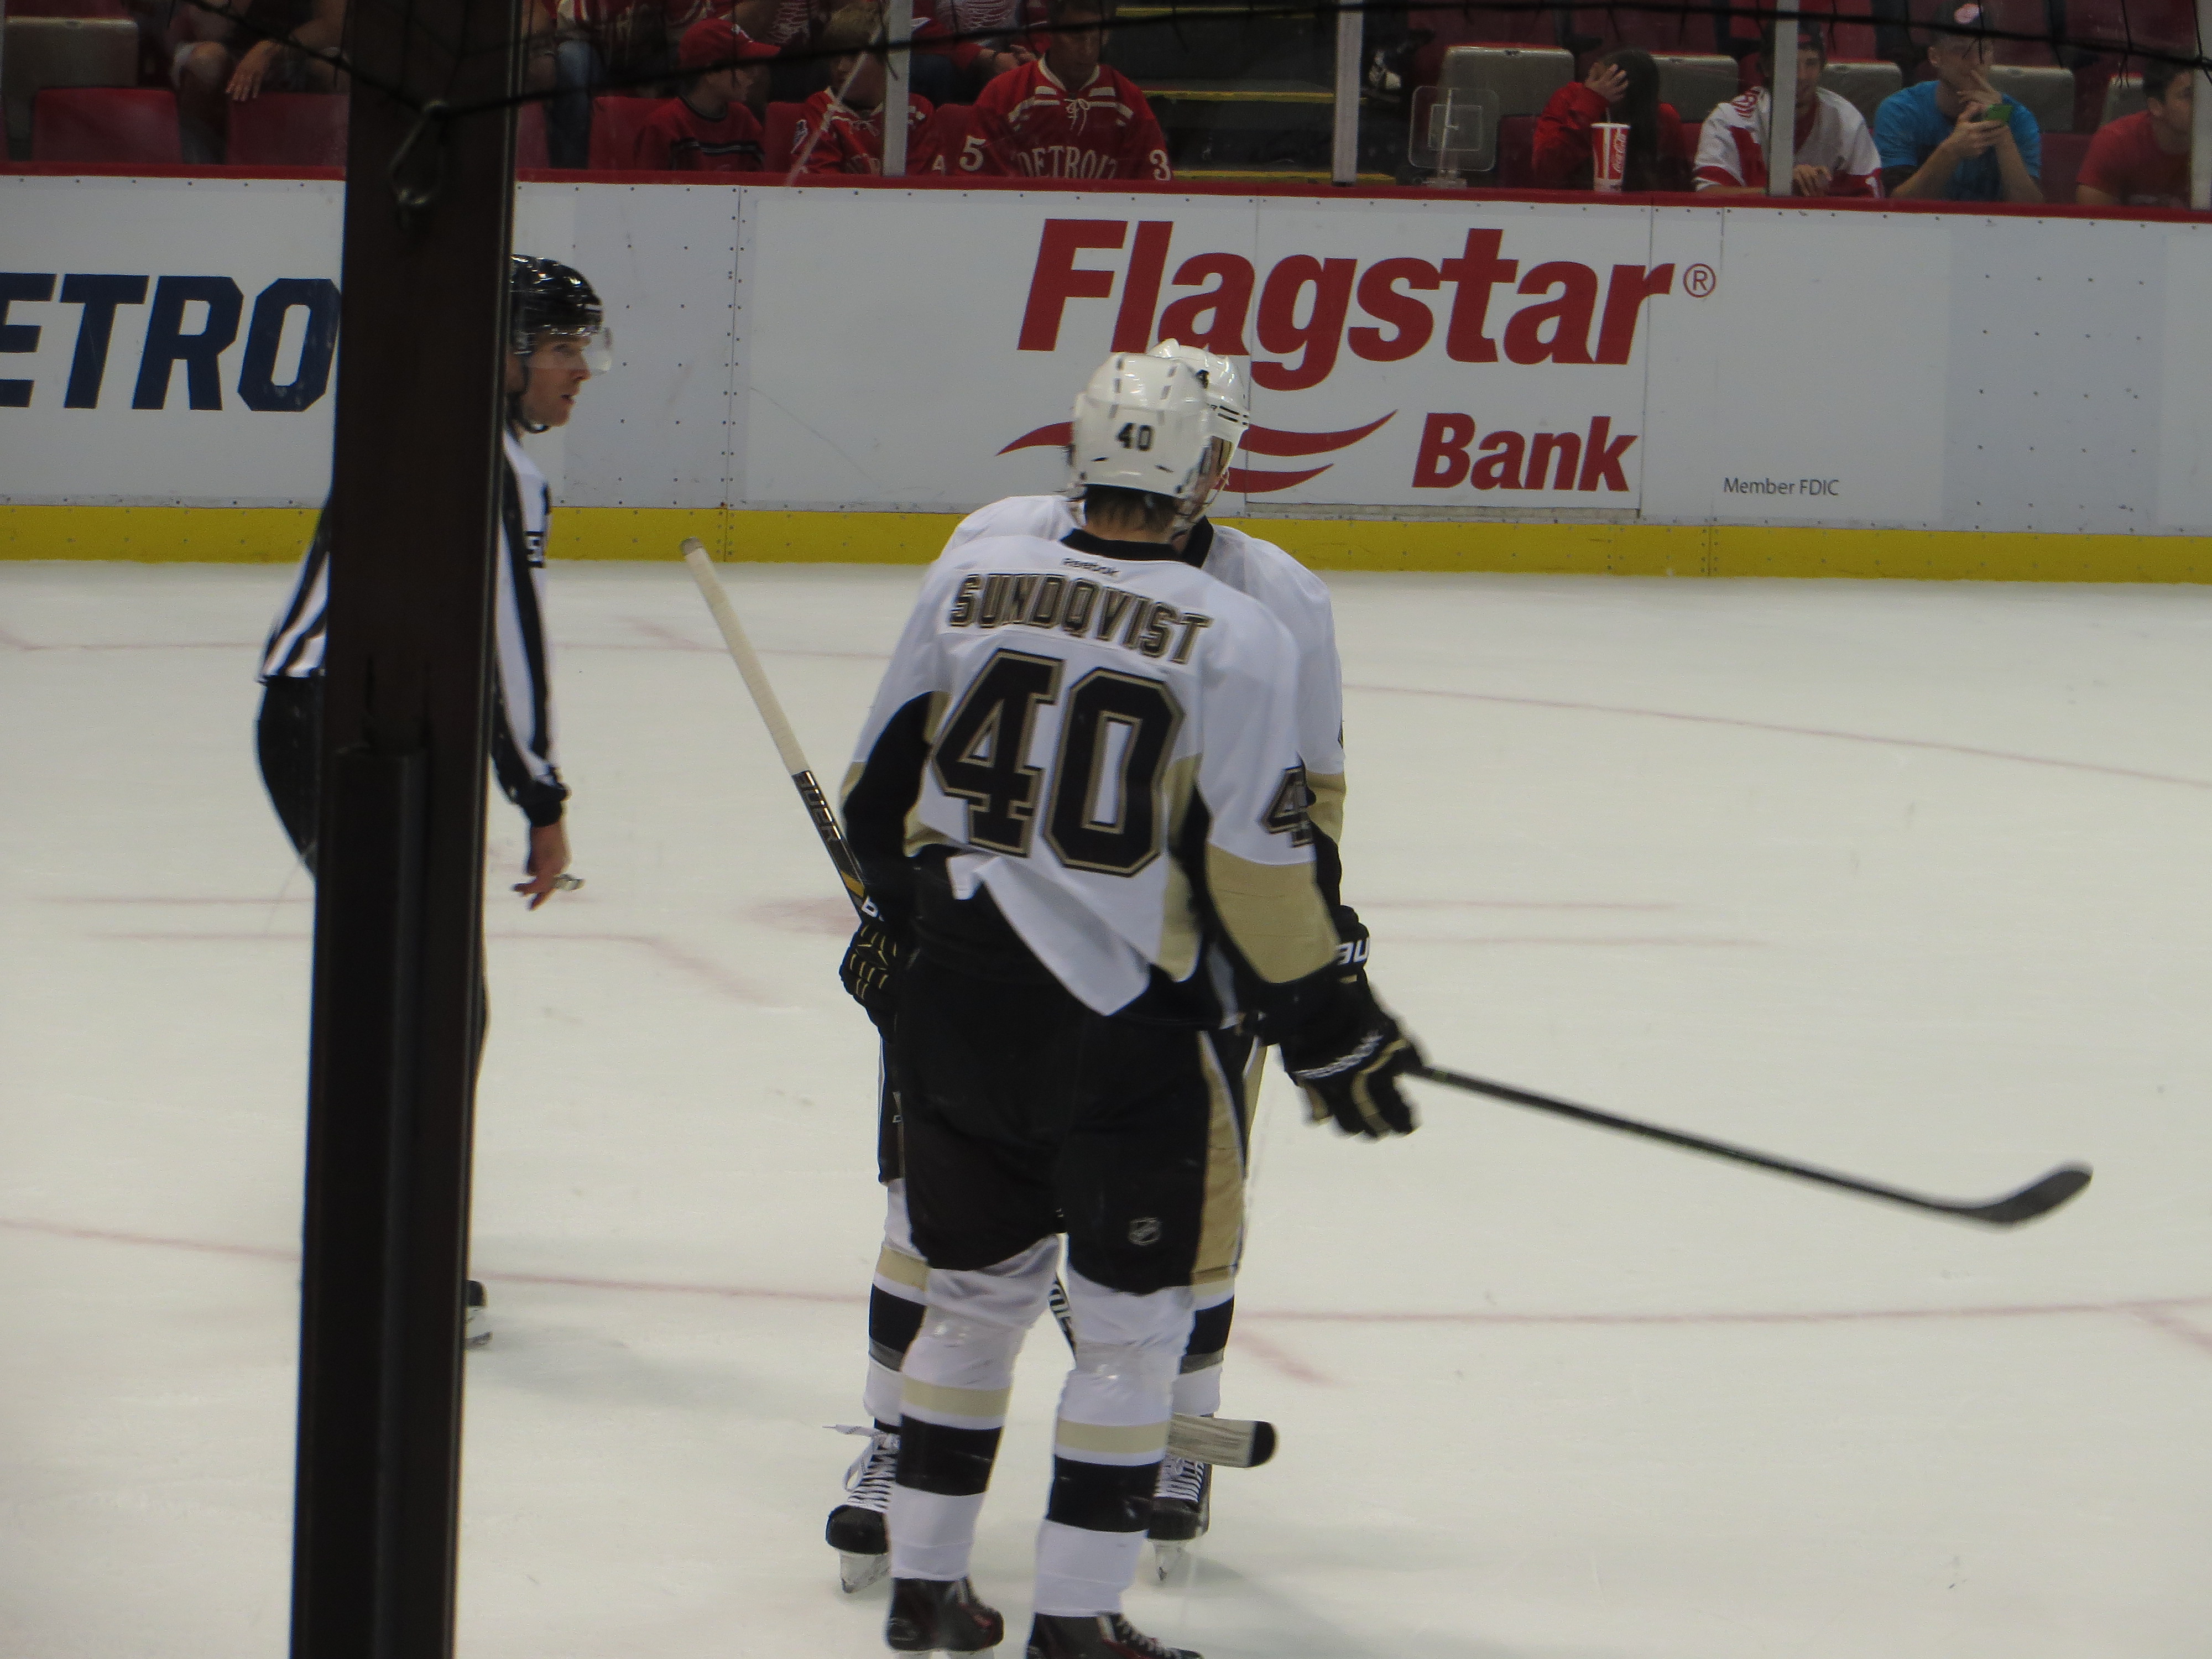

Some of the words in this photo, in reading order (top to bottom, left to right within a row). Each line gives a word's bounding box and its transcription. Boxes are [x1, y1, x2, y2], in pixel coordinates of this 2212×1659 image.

[959, 134, 986, 172] 5
[1149, 149, 1172, 181] 3
[1017, 218, 1674, 391] Flagstar
[1117, 422, 1155, 452] 40
[1413, 413, 1637, 492] Bank
[1723, 477, 1795, 495] Member
[1799, 479, 1840, 496] FDIC
[948, 572, 1213, 665] SUNDQVIST
[932, 648, 1185, 877] 40
